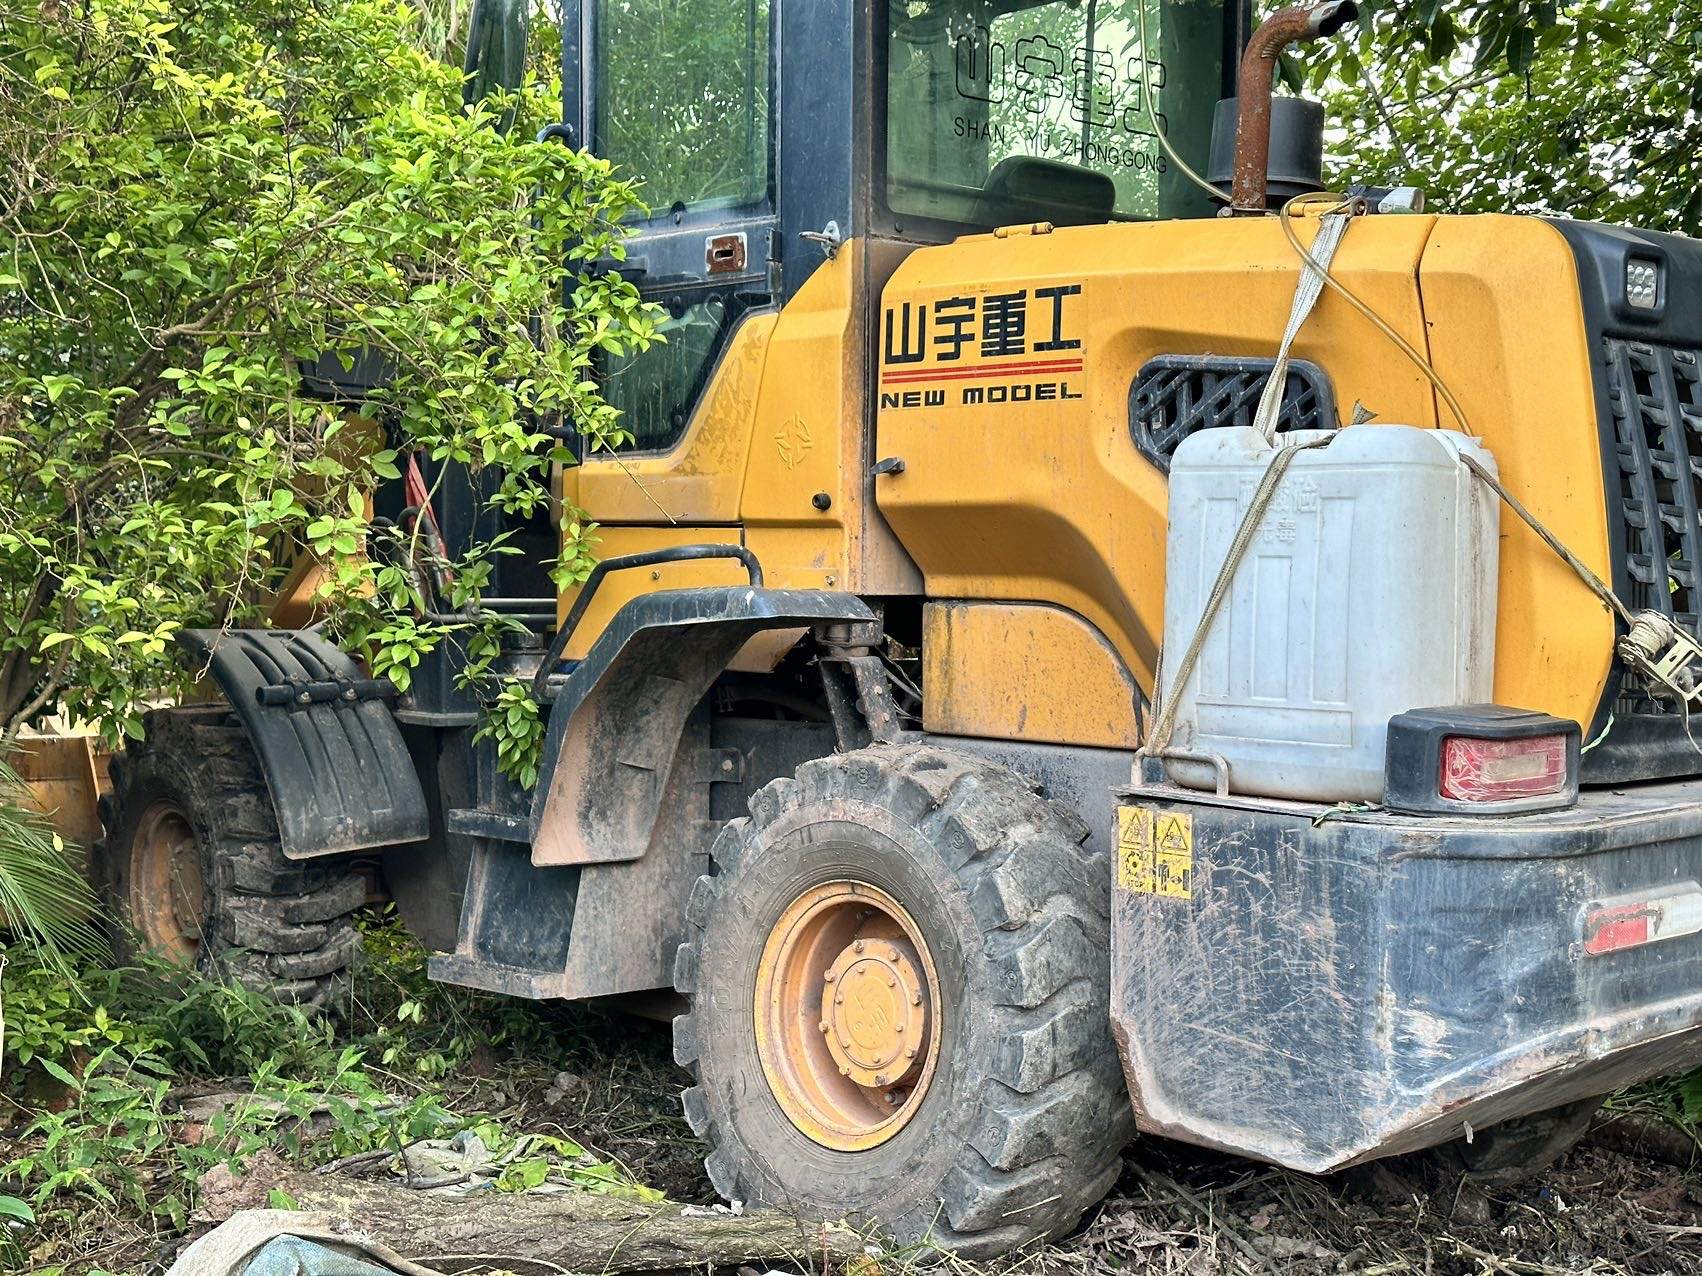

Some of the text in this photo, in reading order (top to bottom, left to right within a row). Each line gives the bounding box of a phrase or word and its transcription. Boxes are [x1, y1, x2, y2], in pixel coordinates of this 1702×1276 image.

[953, 116, 1005, 144] SHAN
[1028, 130, 1051, 151] YU
[885, 284, 1082, 364] 山宇重工
[881, 382, 1082, 409] NEW MODEL
